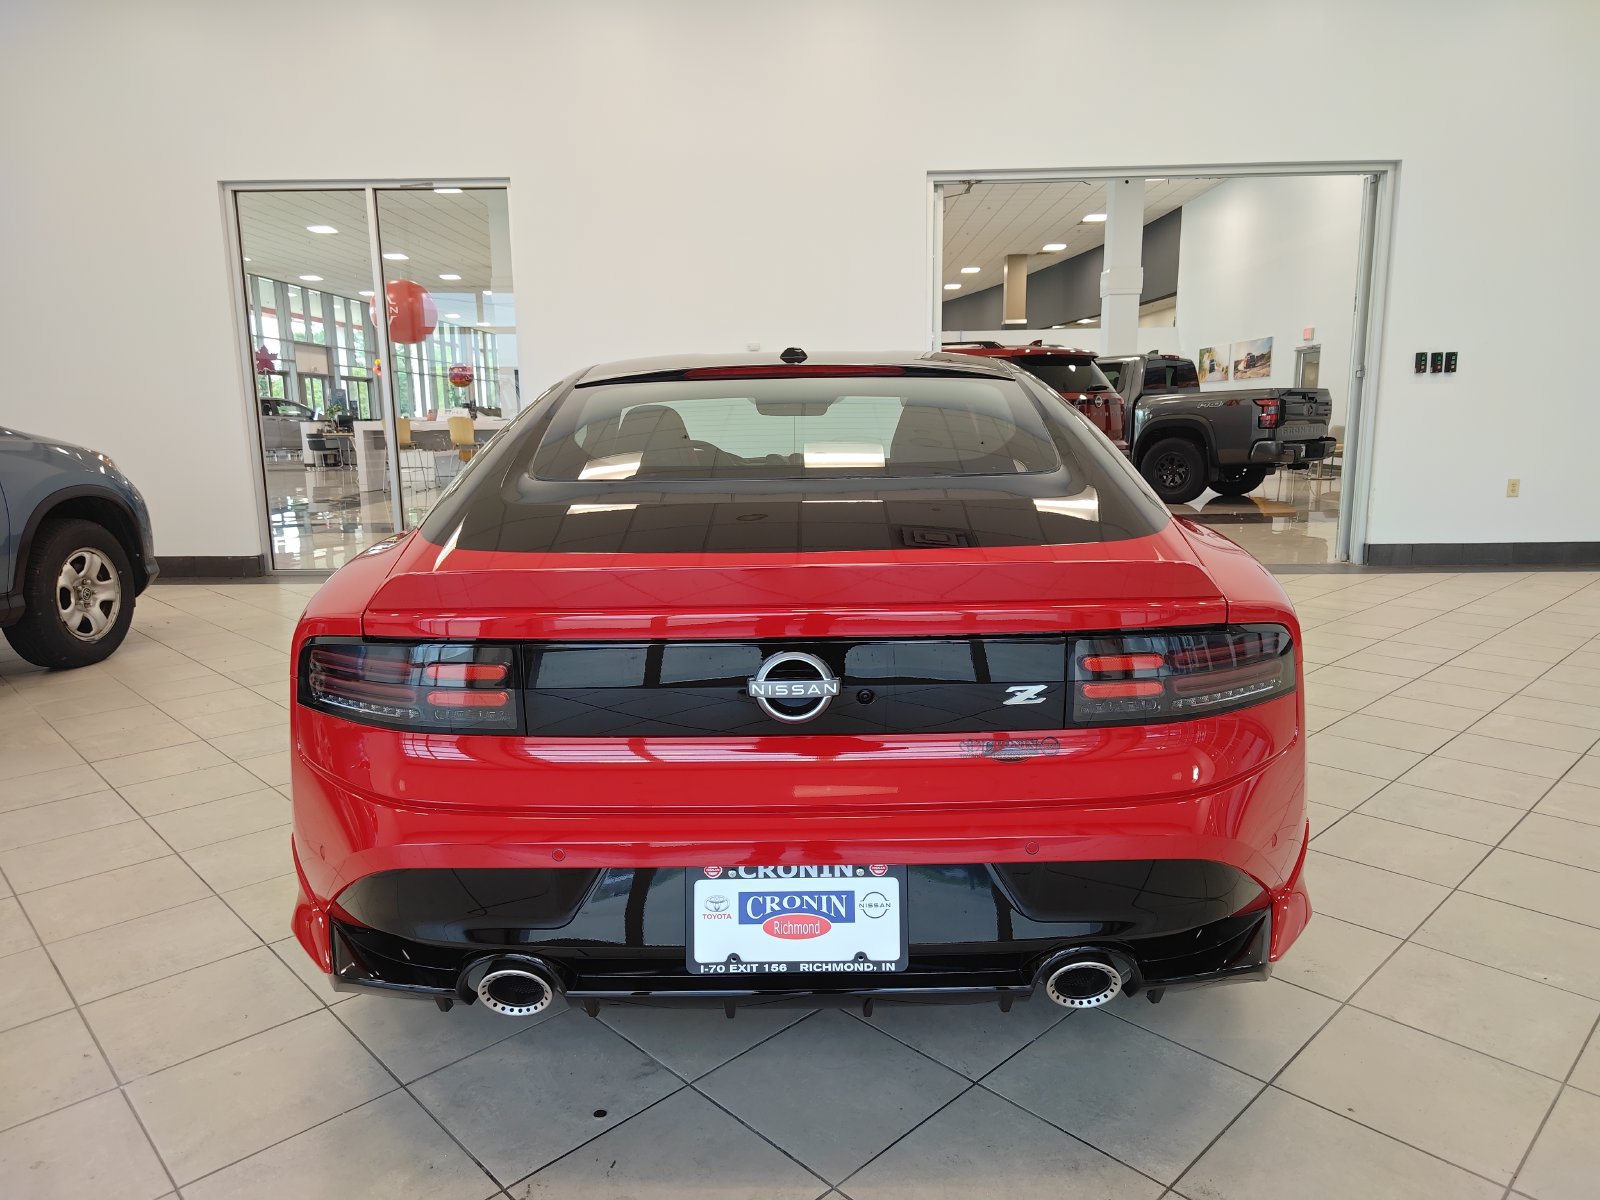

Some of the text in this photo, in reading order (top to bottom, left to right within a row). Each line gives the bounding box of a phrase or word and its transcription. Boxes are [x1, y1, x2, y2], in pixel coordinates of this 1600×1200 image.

[751, 682, 838, 696] NISSAN
[1002, 684, 1048, 705] Z
[738, 865, 853, 879] CRONIN
[746, 894, 847, 920] CRONIN
[773, 920, 821, 935] Richmond
[700, 962, 896, 974] I-70 EXIT 156 RICHMOND, IN
